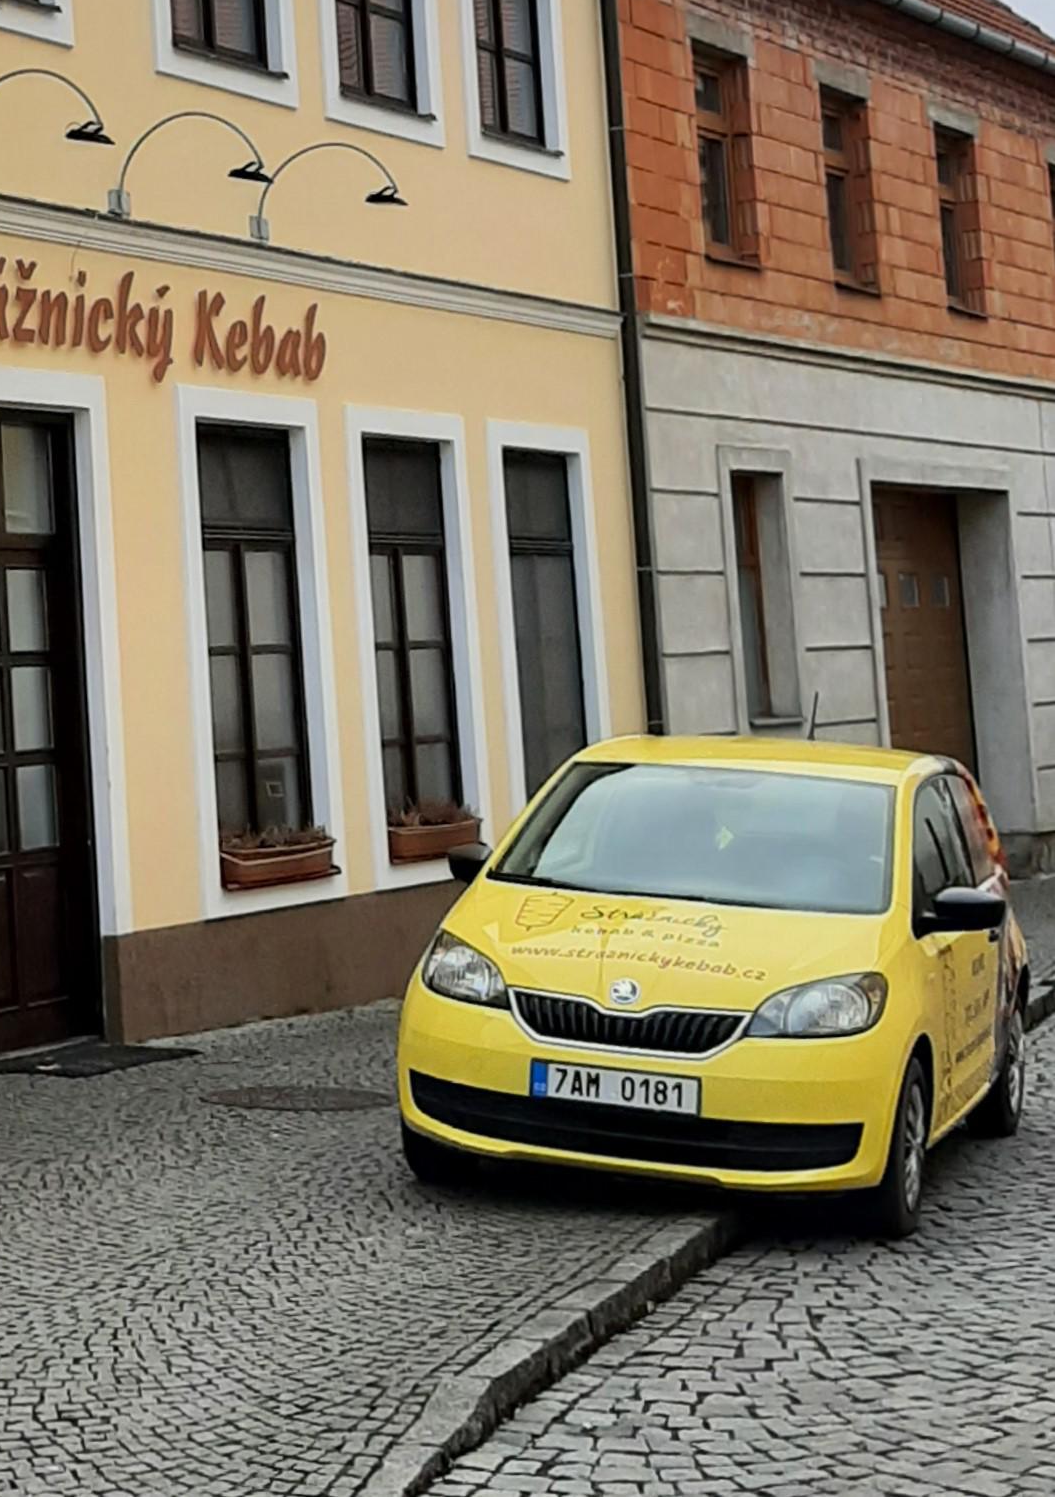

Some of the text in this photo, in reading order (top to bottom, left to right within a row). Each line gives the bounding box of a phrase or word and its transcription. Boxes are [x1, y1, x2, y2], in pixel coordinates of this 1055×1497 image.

[193, 288, 327, 382] Kebab
[555, 1067, 684, 1109] 7AM 0181
